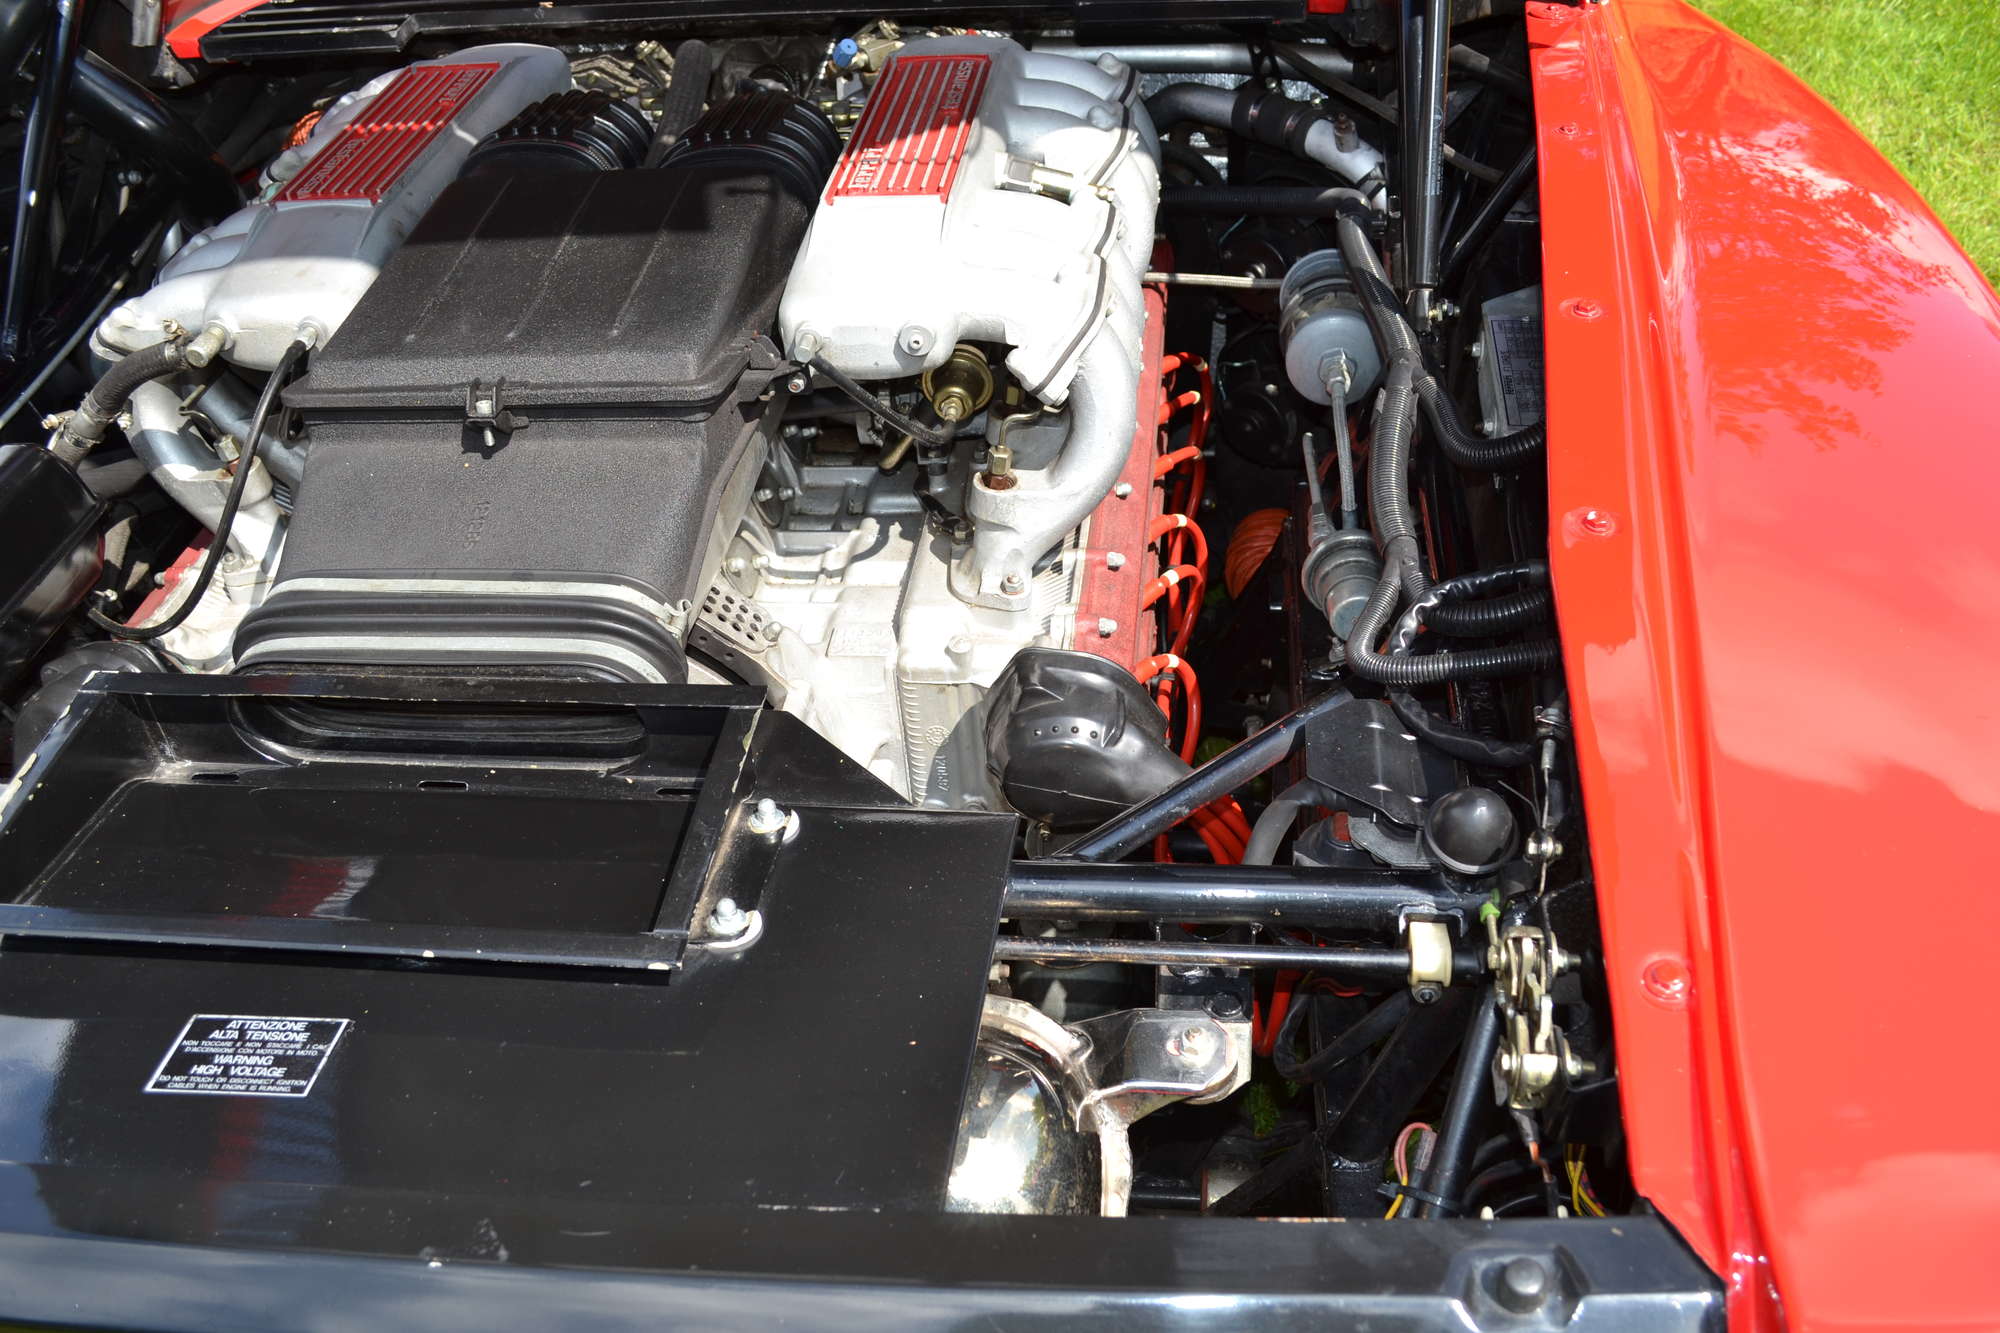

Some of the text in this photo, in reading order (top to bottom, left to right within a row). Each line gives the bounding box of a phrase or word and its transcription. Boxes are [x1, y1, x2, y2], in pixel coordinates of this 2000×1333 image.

[226, 1020, 308, 1031] ATTENZIONE
[208, 1029, 311, 1042] ALTA TENSIONE
[214, 1054, 274, 1066] WARNING
[190, 1065, 287, 1078] HIGH VOLTAGE
[229, 1077, 275, 1085] DISCONNECT
[275, 1079, 308, 1087] IGNITION
